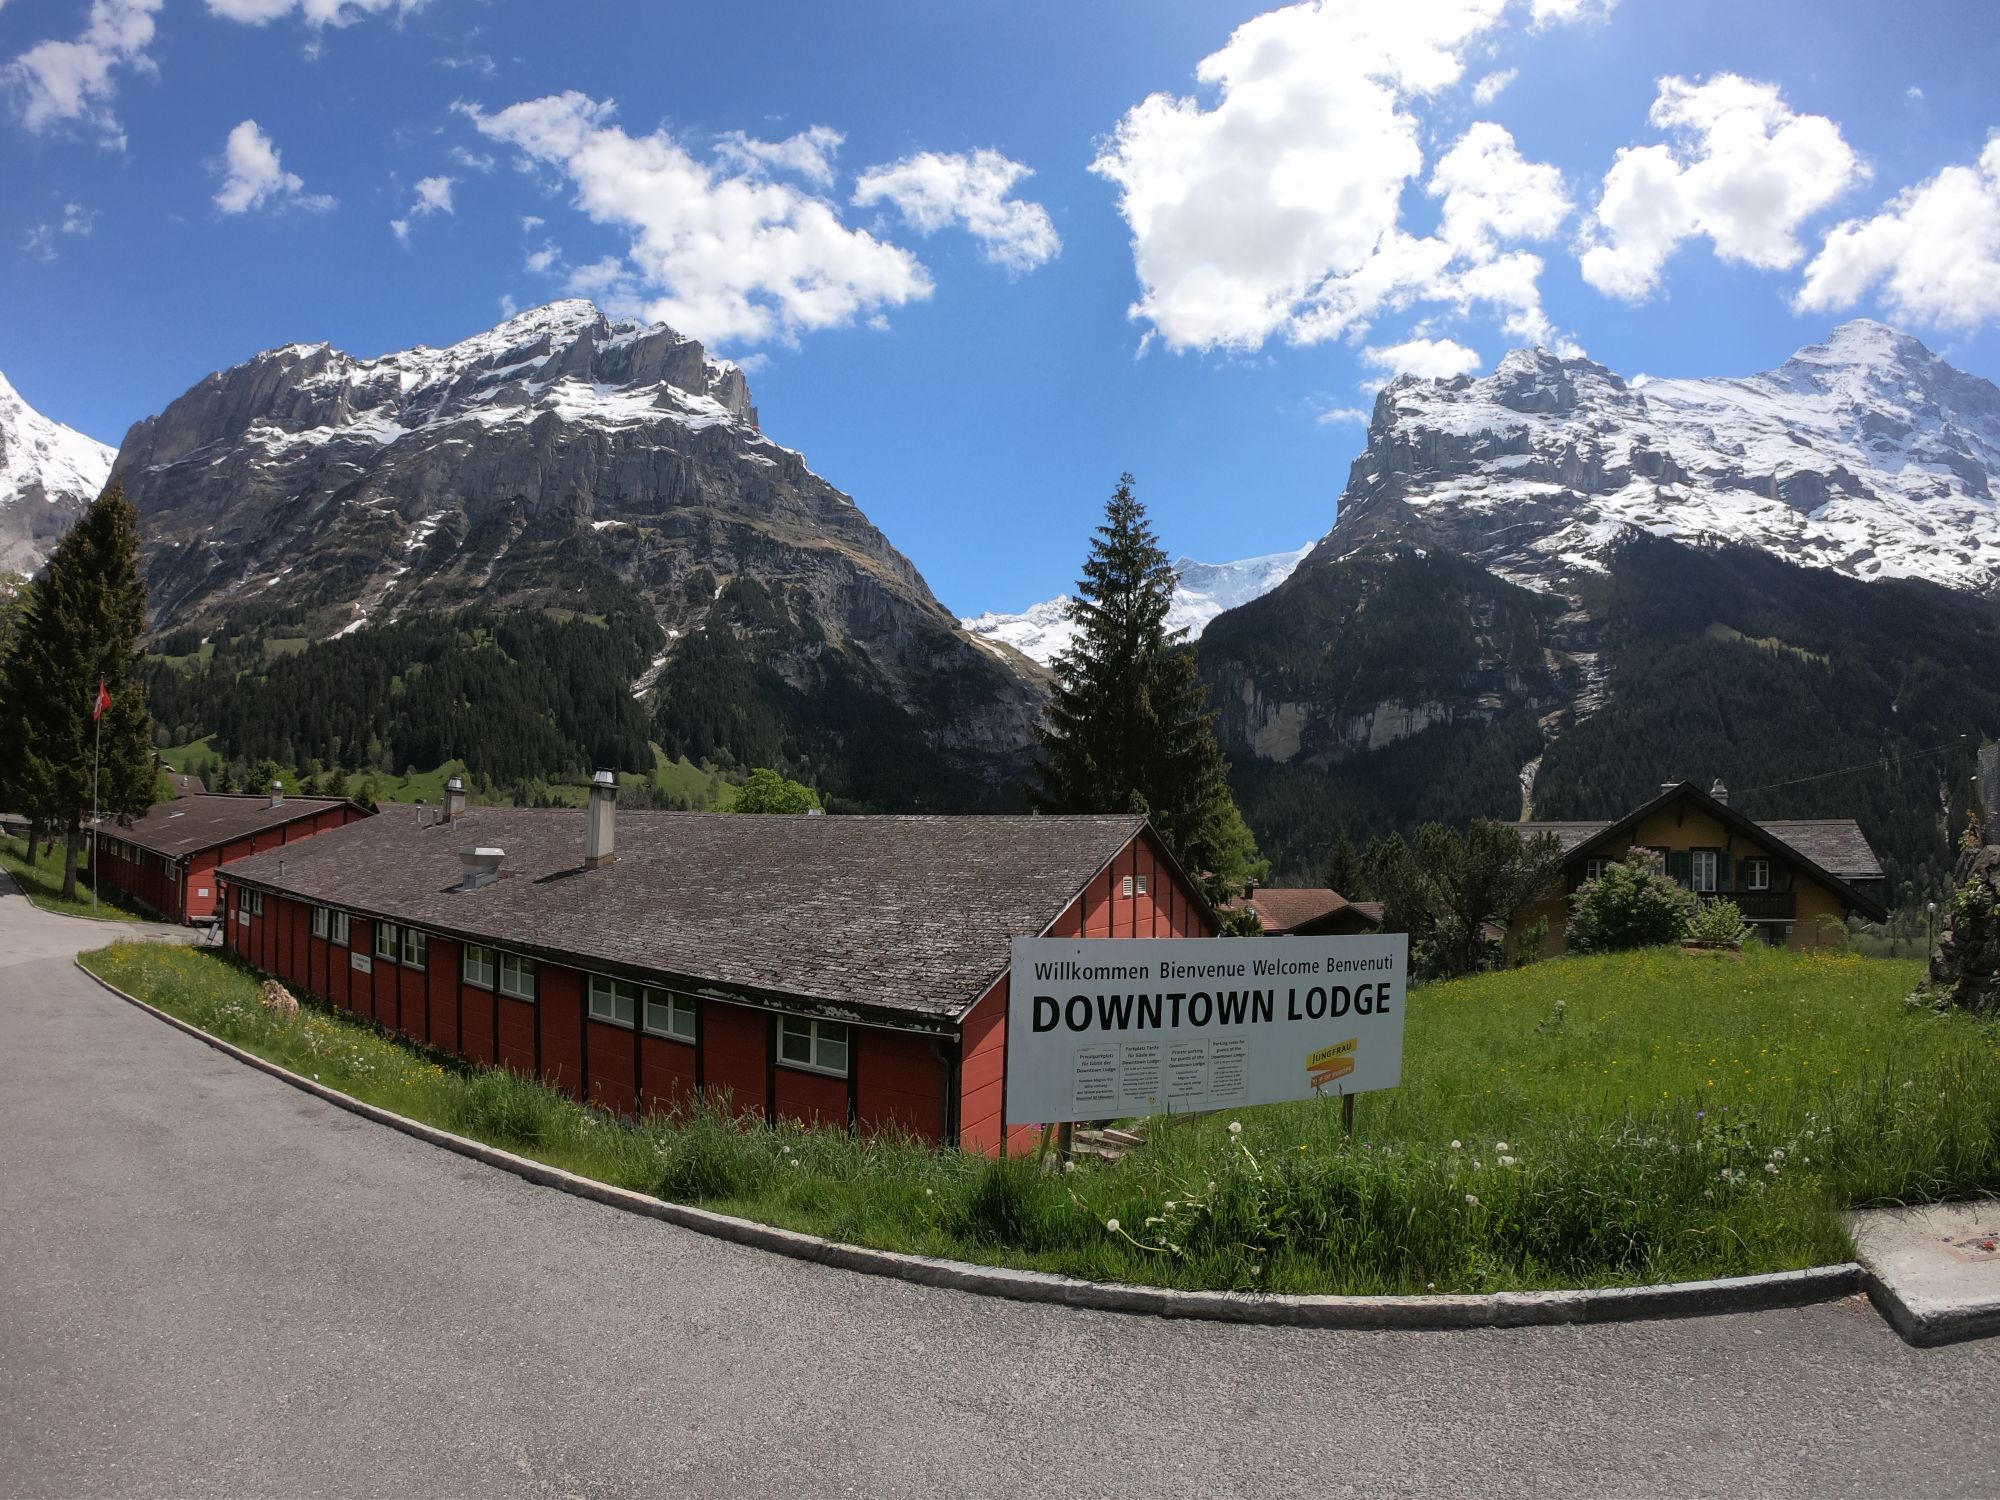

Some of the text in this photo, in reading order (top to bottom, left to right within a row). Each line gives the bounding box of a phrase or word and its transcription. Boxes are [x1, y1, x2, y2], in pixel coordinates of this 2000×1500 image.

[1034, 954, 1393, 981] Willkommen Bienvenue Welcome Benvenuti
[1032, 982, 1391, 1033] DOWNTOWN LODGE
[1312, 1042, 1352, 1065] JUNGFRAU
